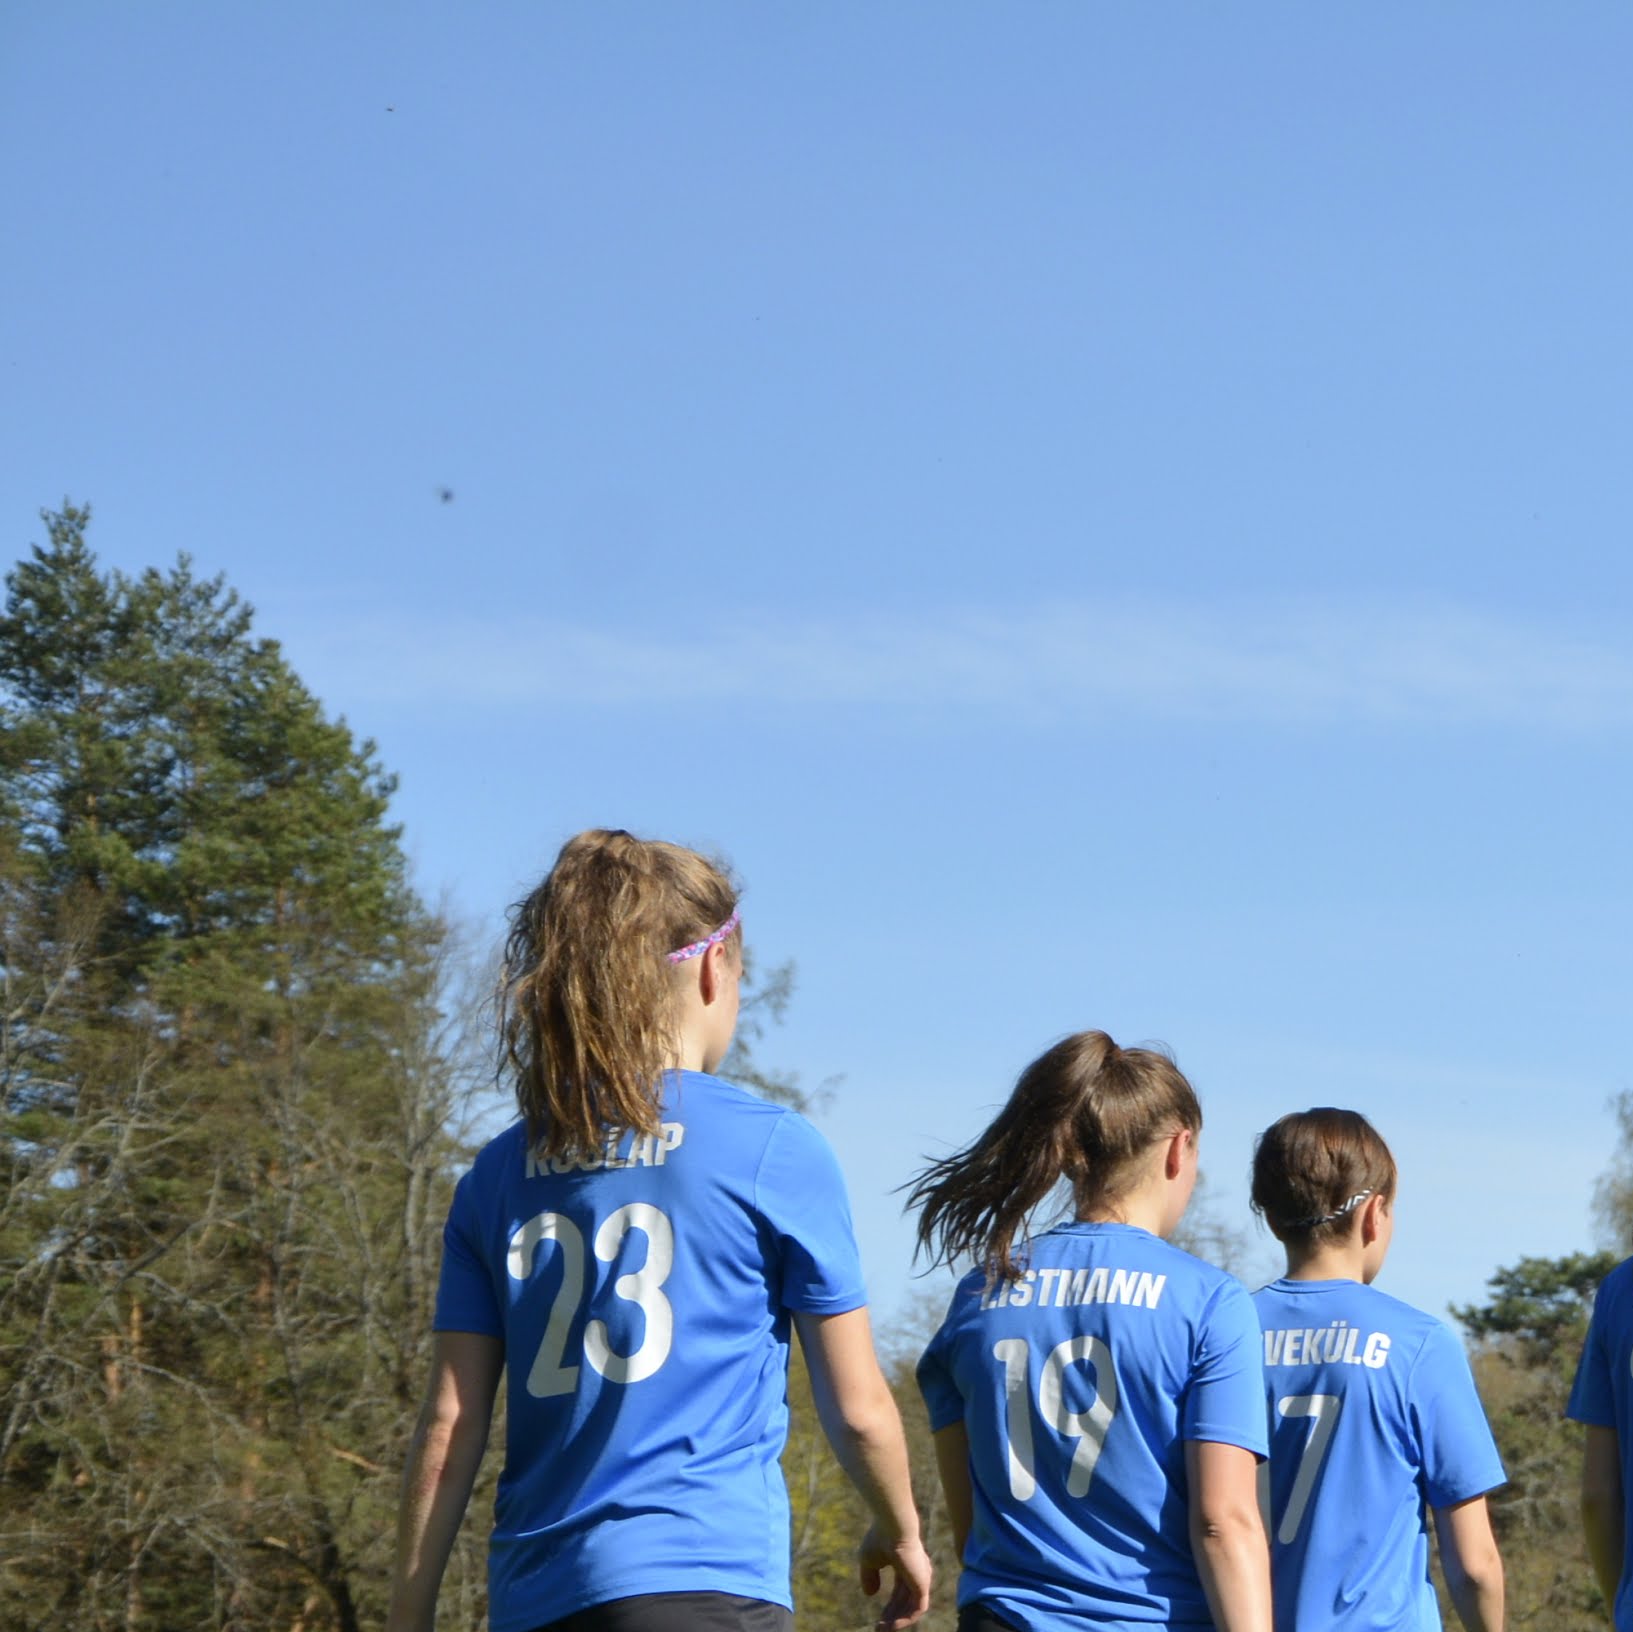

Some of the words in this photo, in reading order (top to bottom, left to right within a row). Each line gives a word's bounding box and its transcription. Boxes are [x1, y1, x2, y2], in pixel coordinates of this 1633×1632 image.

[507, 1202, 673, 1398] 23
[1262, 1321, 1392, 1369] VEKÜLG
[993, 1336, 1117, 1500] 19
